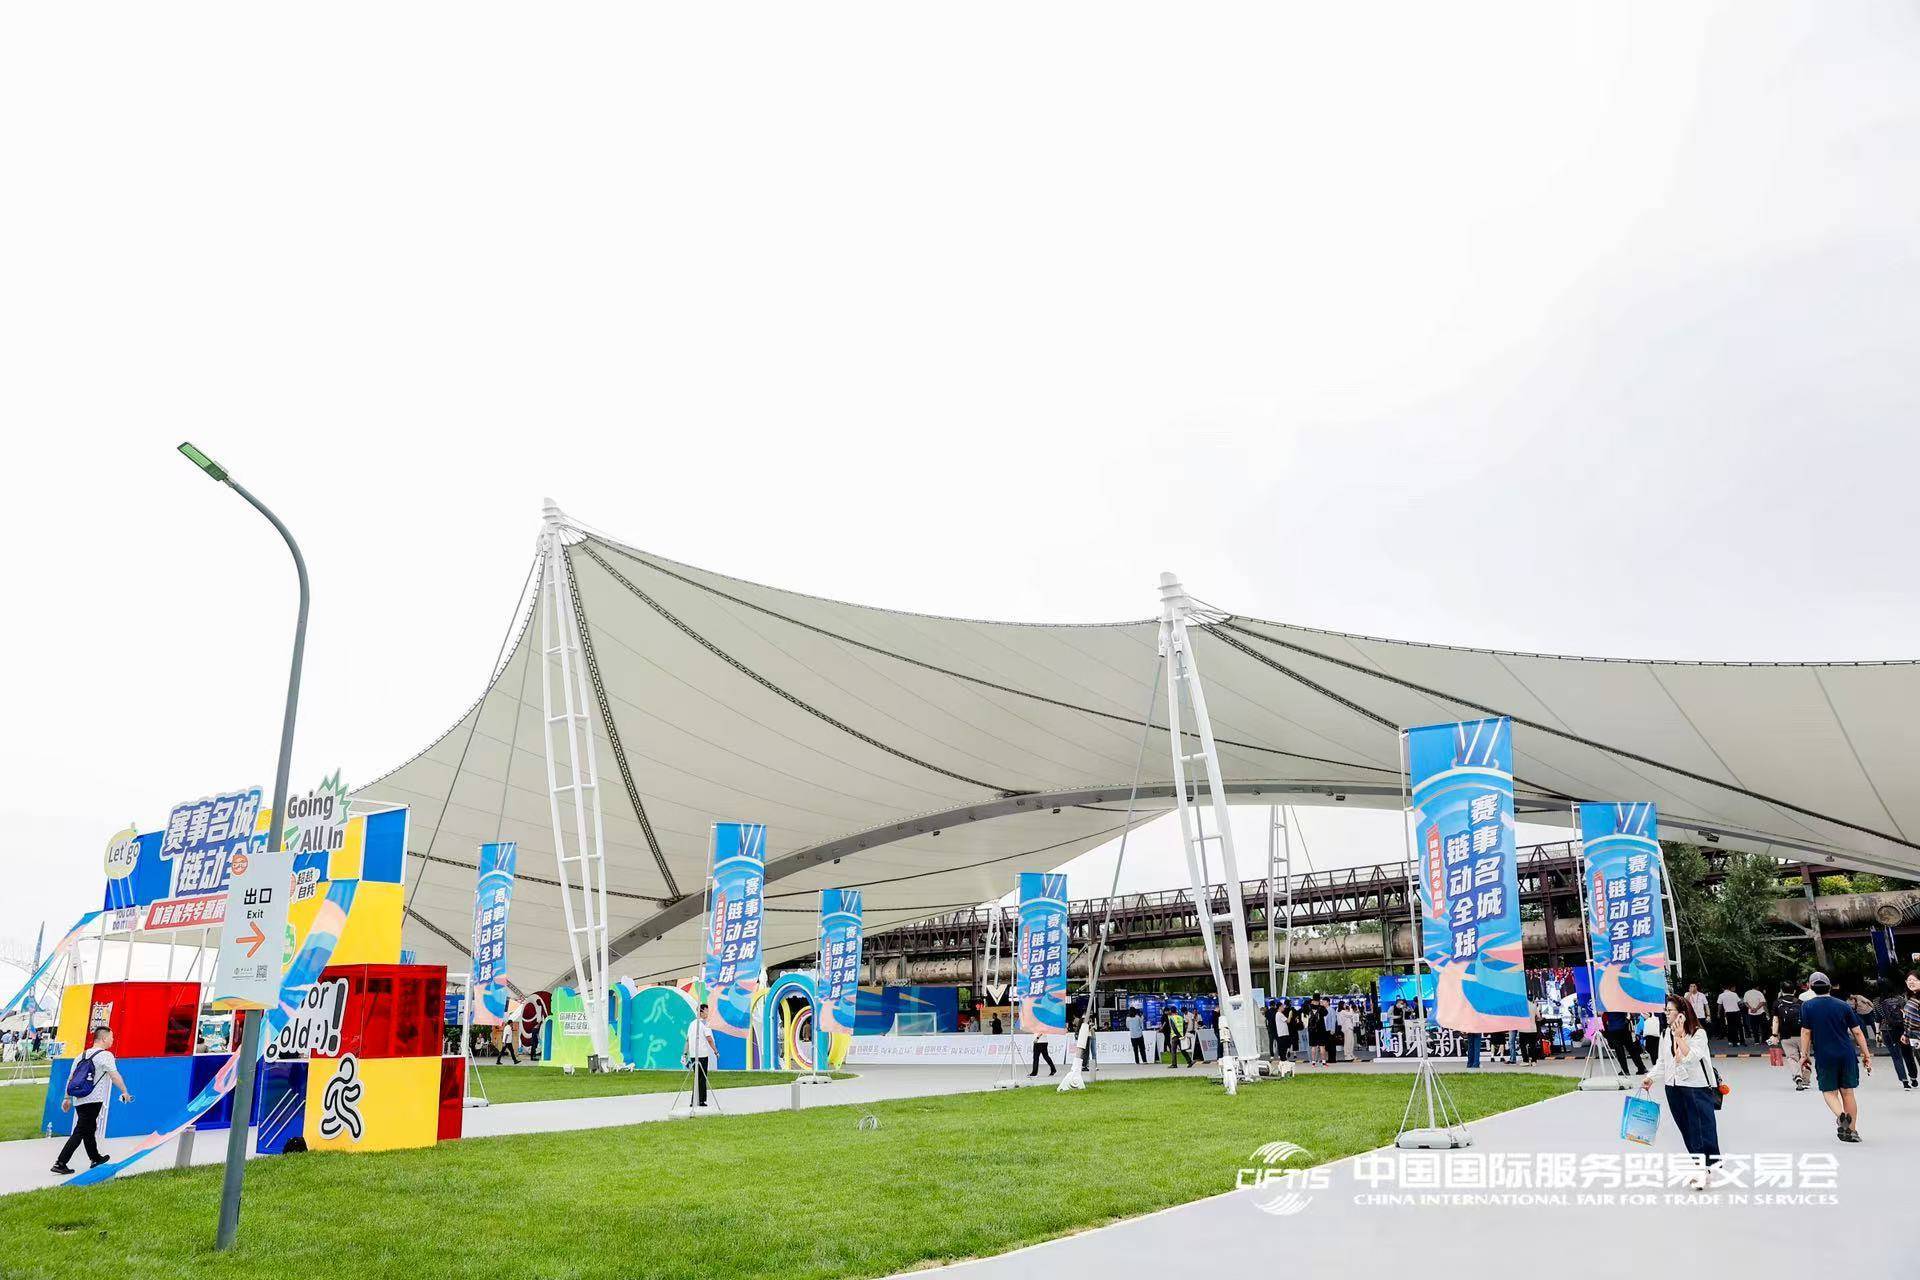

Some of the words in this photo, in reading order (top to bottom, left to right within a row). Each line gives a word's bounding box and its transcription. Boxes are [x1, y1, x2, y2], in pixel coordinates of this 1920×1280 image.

[164, 794, 258, 852] 赛事名城
[287, 791, 334, 821] Going
[300, 825, 324, 852] All
[327, 826, 344, 849] In
[1470, 793, 1503, 921] 赛事名城
[243, 887, 273, 905] 出口
[246, 909, 264, 919] Exit
[297, 882, 316, 899] 自我
[737, 877, 760, 961] 赛事名城
[1446, 834, 1478, 960] 链动全球
[1608, 879, 1632, 963] 链动全球
[1628, 854, 1652, 938] 赛事名城
[718, 900, 745, 984] 链动全球
[1029, 931, 1046, 996] 链动全球
[1046, 913, 1061, 978] 赛事名城
